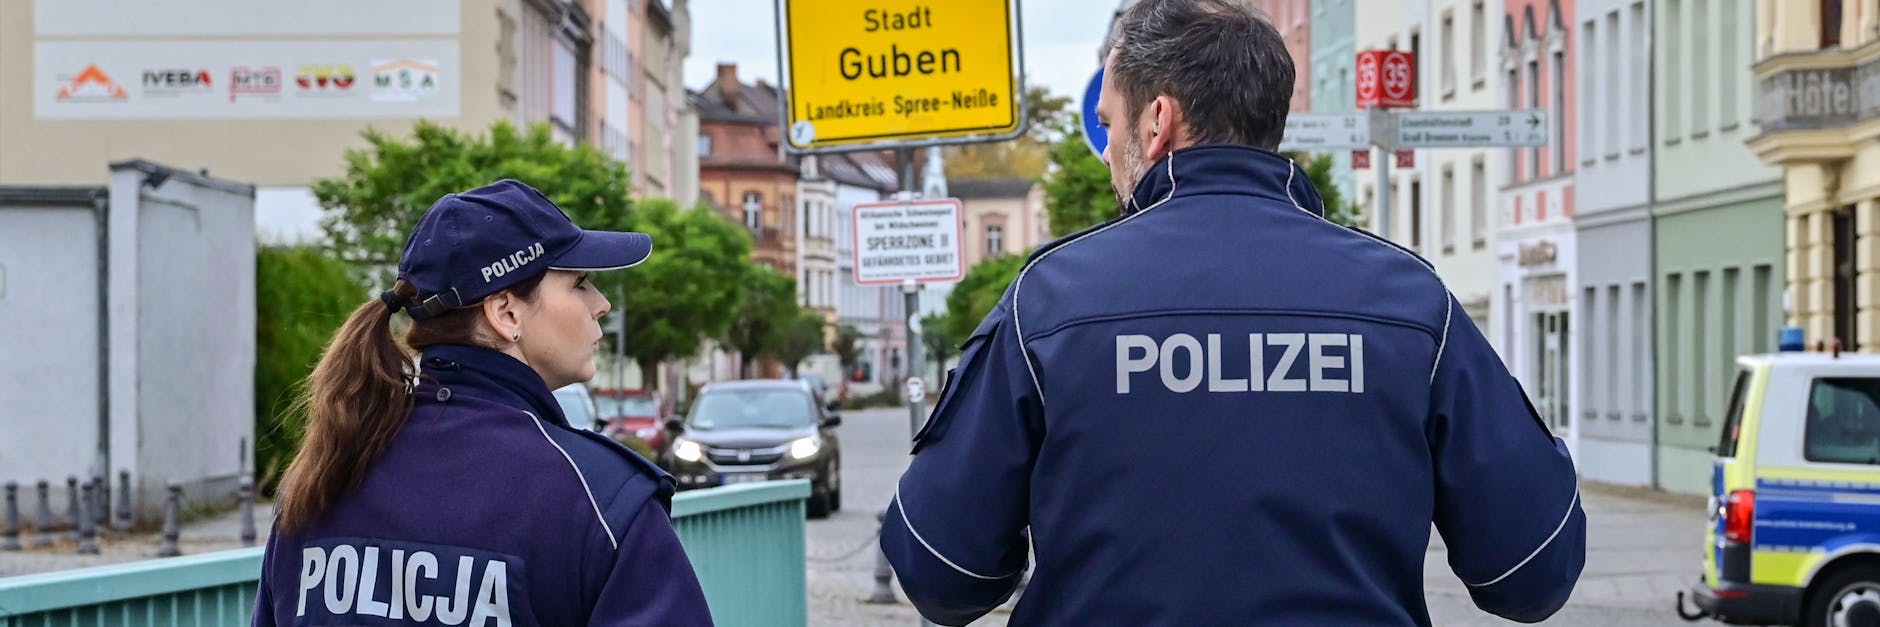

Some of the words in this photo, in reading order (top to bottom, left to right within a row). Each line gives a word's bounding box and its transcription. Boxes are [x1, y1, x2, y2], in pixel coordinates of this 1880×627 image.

[864, 7, 932, 32] Stadt
[840, 44, 961, 80] Guben
[1359, 62, 1375, 89] 35
[1383, 62, 1408, 89] 35
[143, 70, 212, 88] IVEBA
[806, 97, 885, 121] Landkreis
[894, 88, 998, 118] Spree-Neiße
[866, 233, 935, 252] SPERRZONE
[481, 242, 544, 283] POLICJA
[1116, 333, 1364, 393] POLIZEI
[297, 545, 512, 627] POLICJA
